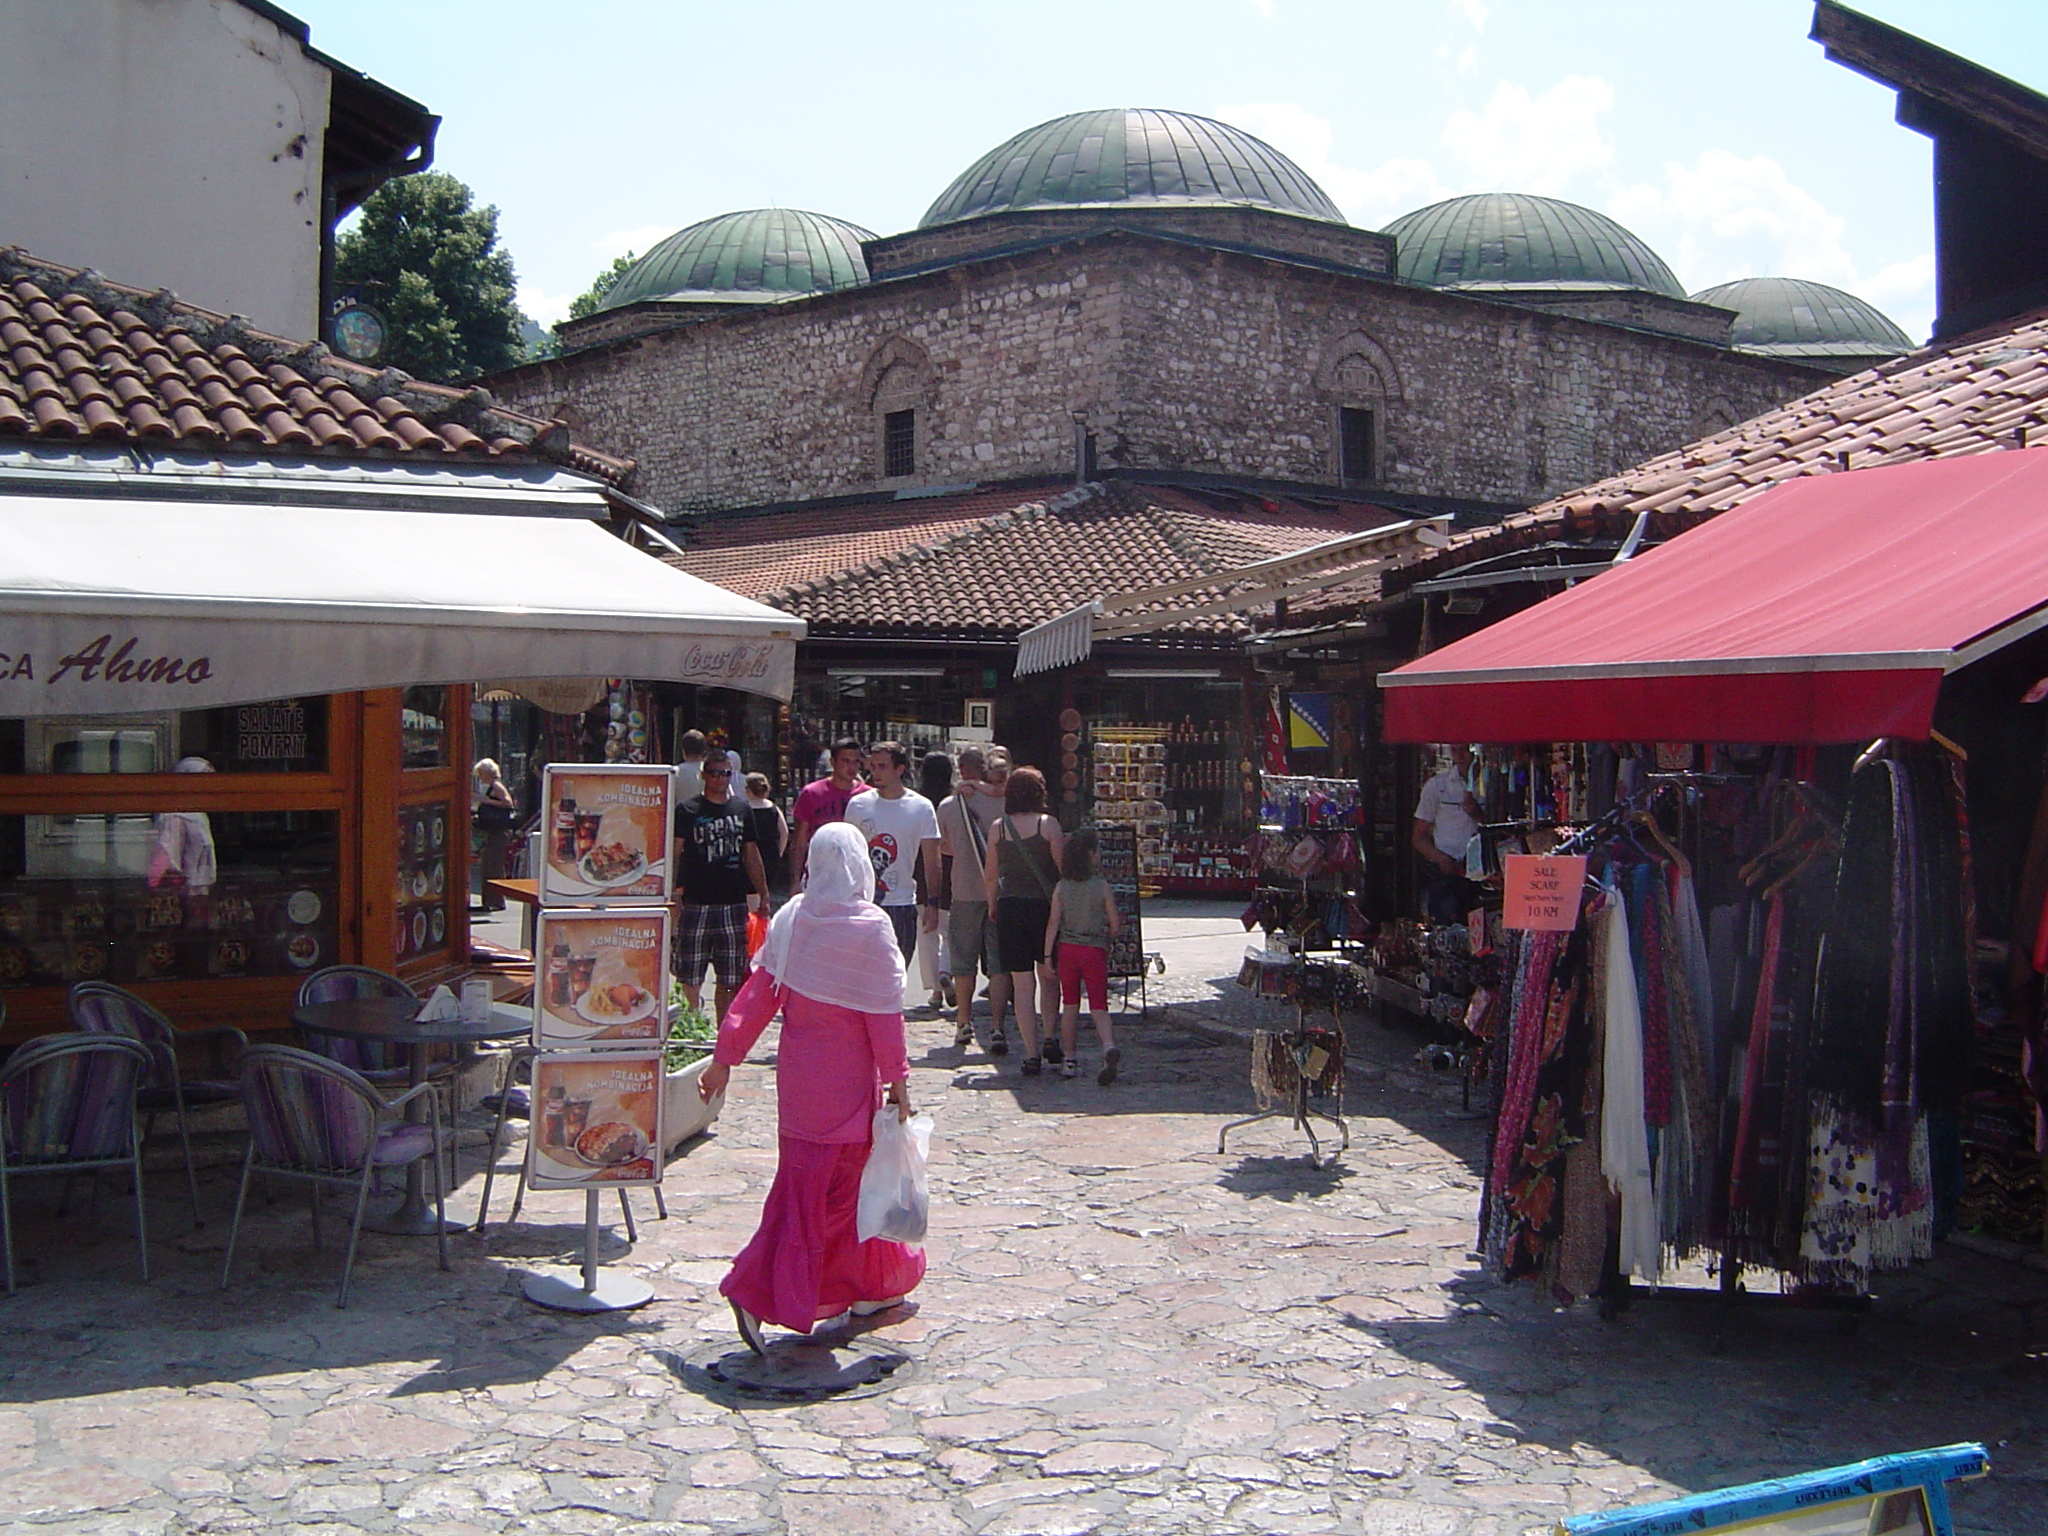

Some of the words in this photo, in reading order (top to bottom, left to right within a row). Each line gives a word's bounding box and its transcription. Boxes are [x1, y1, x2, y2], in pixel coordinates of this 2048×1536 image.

[48, 634, 213, 685] Ahmo
[239, 707, 304, 732] SALATE
[239, 733, 305, 758] POMFRIT
[621, 783, 661, 795] IDEALNA
[599, 794, 661, 807] KOMBINACIJA
[1534, 867, 1557, 876] SALE
[1529, 880, 1559, 891] SCARF
[1528, 904, 1540, 917] 10
[1544, 905, 1559, 917] KM
[615, 927, 656, 938] IDEALNA
[591, 936, 656, 949] KOMBINACIJA
[611, 1070, 653, 1080] IDEALNA
[586, 1080, 653, 1092] KOMBINACIJA
